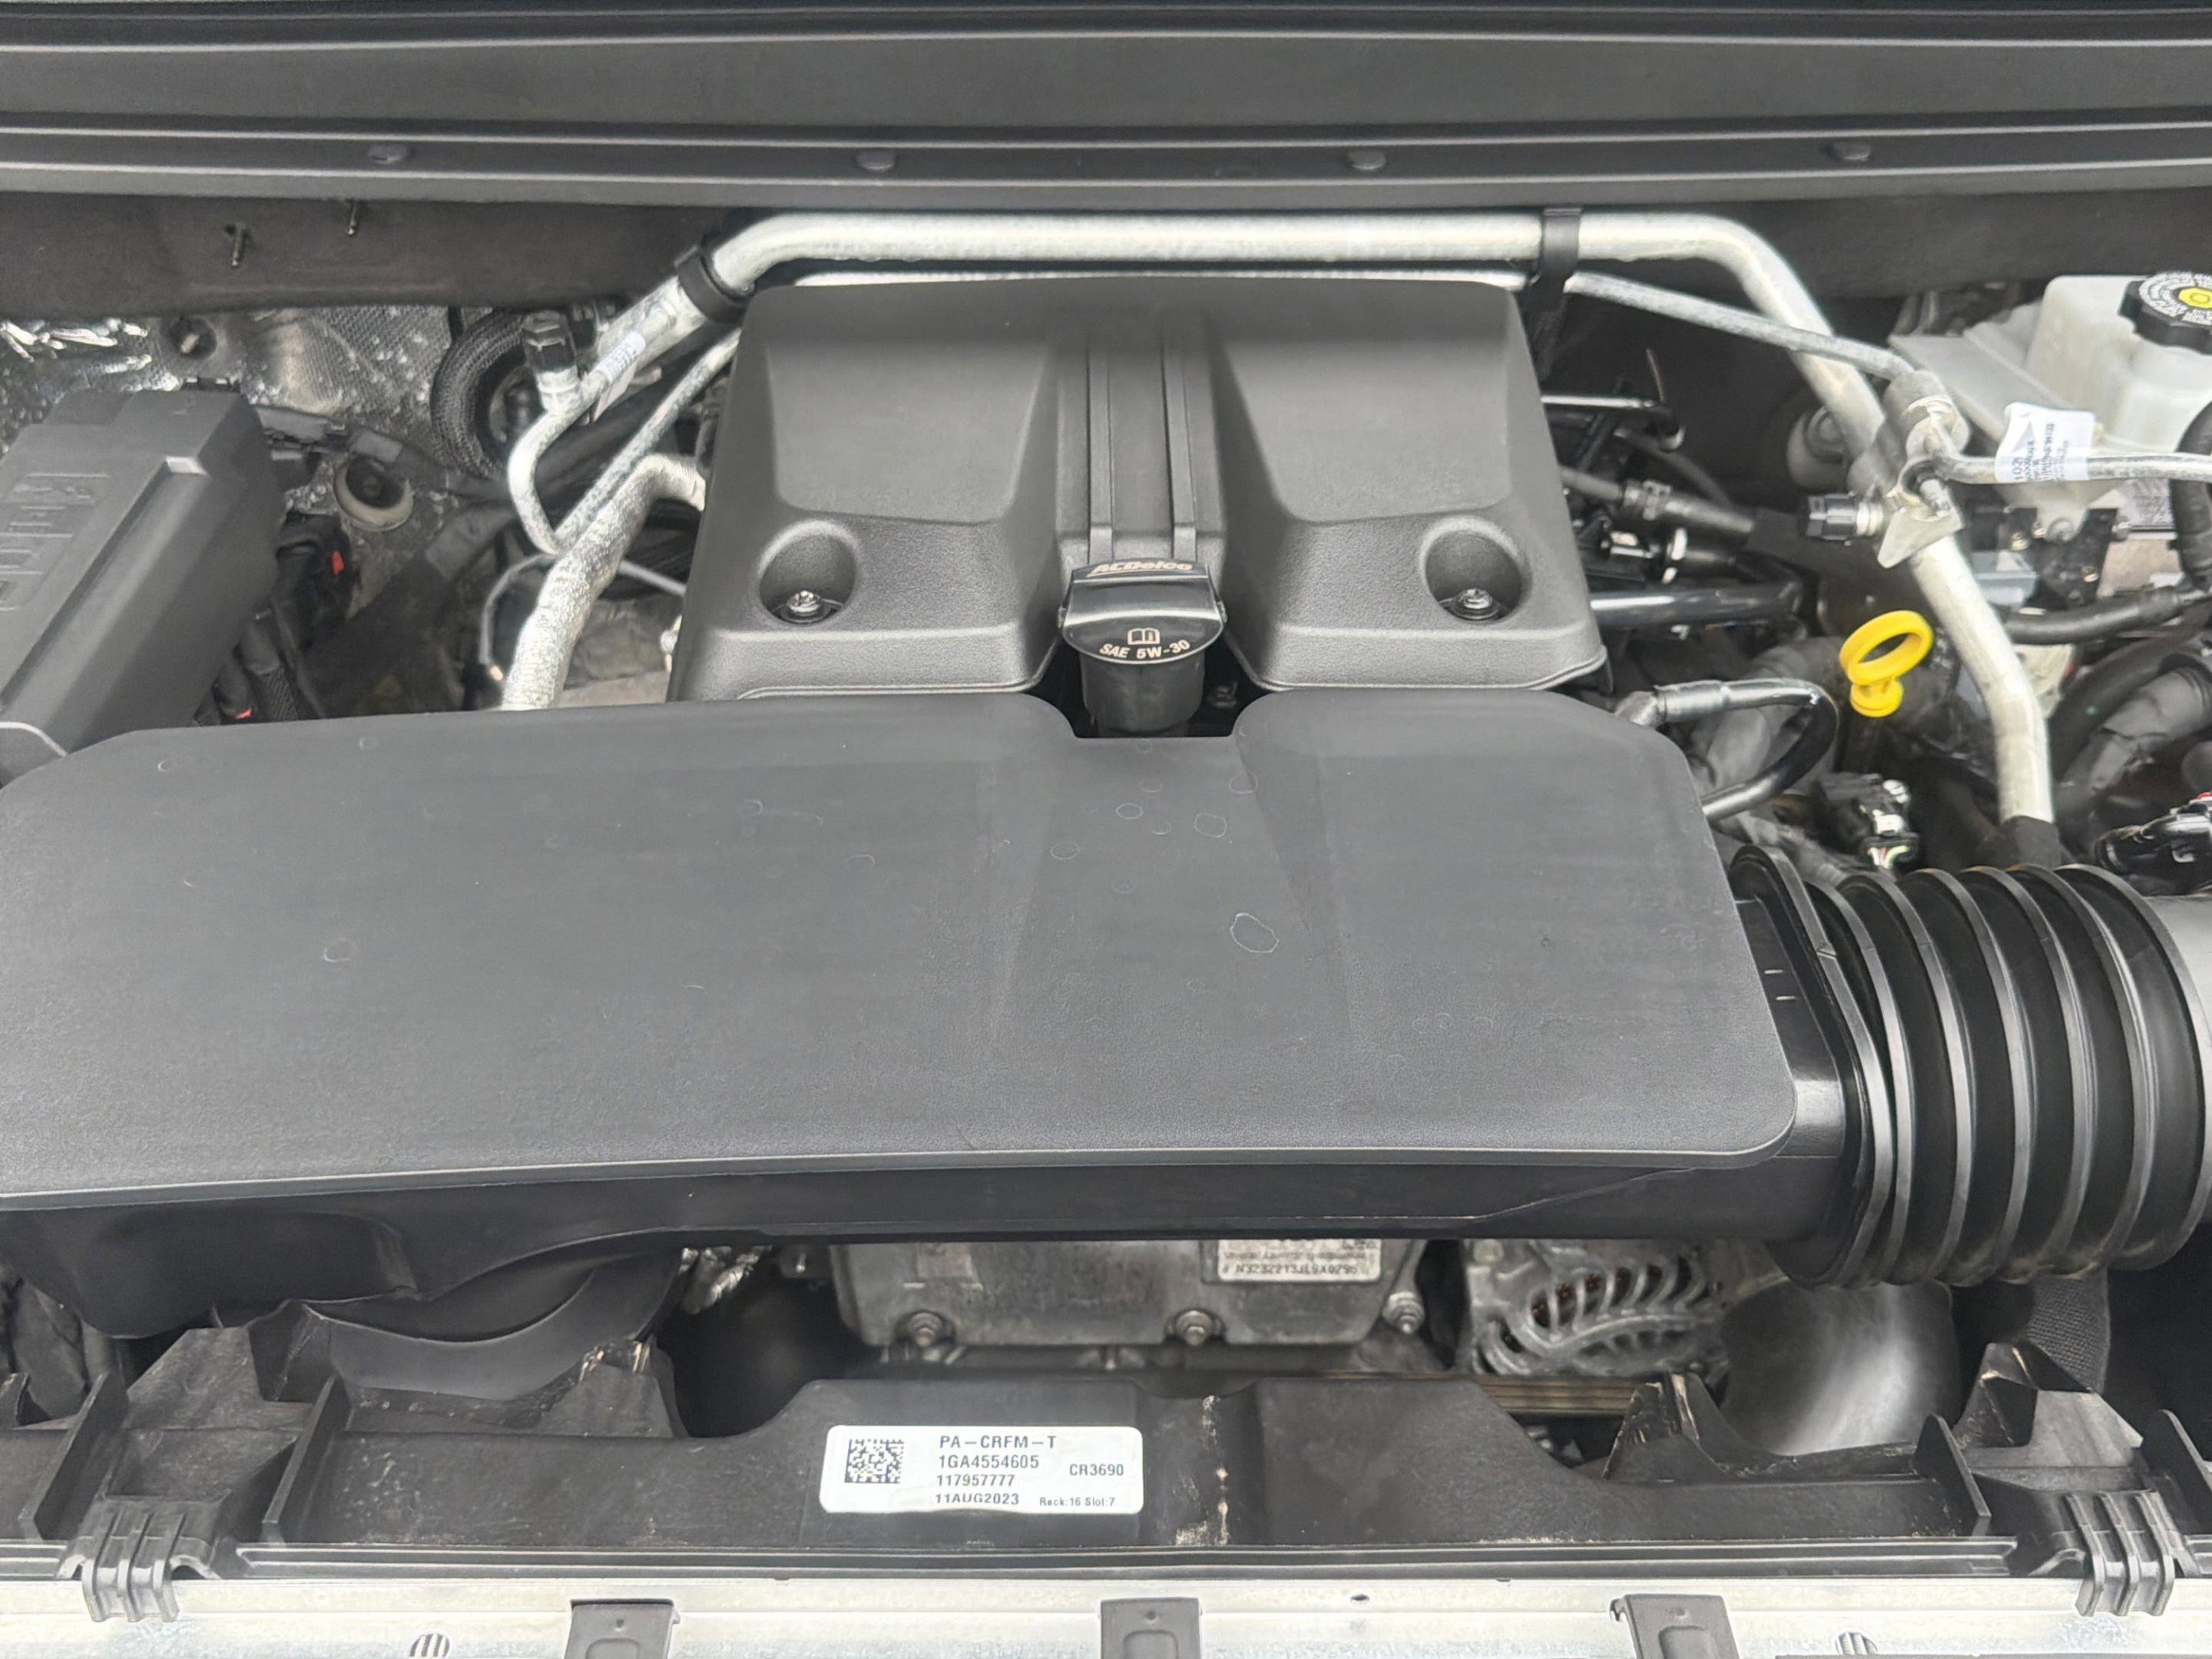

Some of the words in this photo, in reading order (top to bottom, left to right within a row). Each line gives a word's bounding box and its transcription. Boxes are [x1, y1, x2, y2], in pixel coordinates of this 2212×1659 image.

[1088, 561, 1193, 576] ACDelco
[1099, 643, 1131, 658] SAE
[1136, 639, 1190, 659] 5W-30
[939, 1454, 1039, 1469] 1GA4554605
[1069, 1463, 1124, 1476] CR3690
[936, 1474, 1015, 1487] 117957777
[935, 1492, 1019, 1505] 11AUG2023
